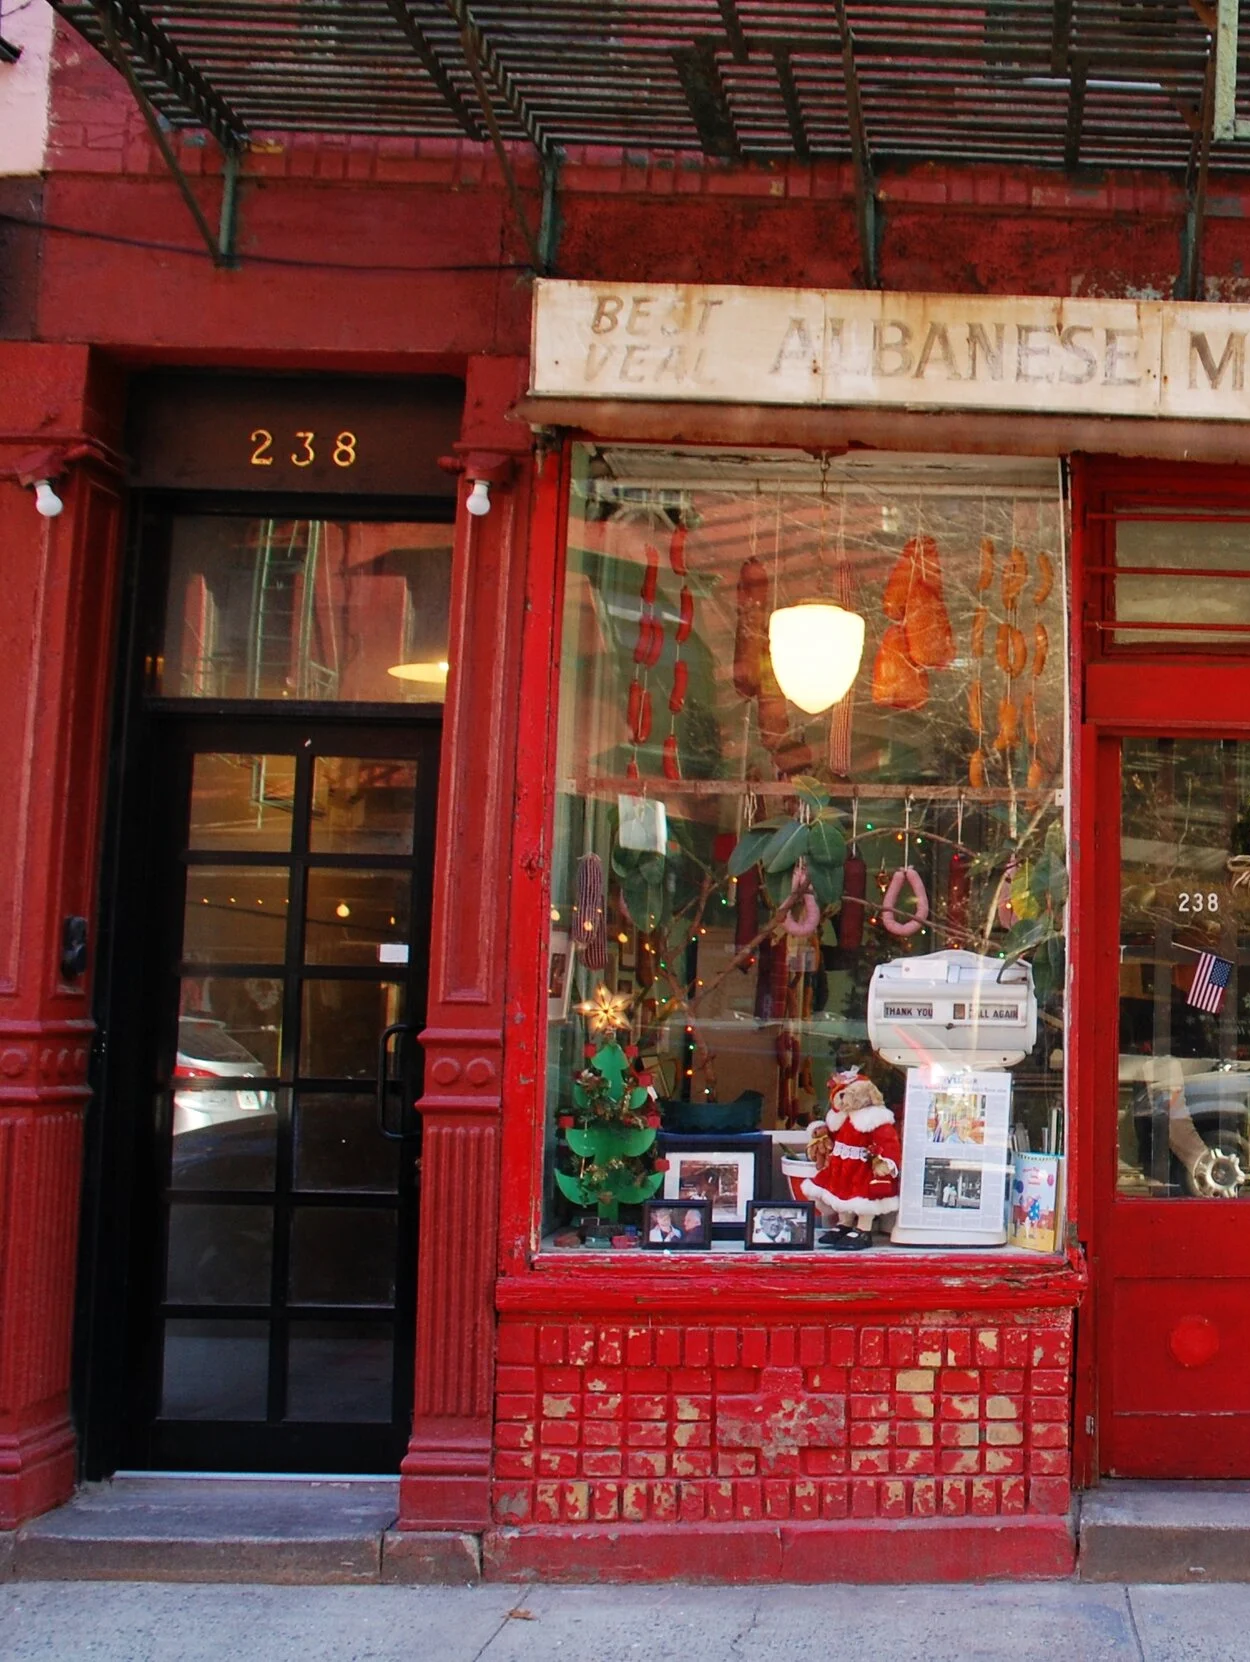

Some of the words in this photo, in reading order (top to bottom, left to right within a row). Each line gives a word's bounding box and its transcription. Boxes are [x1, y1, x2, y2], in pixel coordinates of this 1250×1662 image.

[767, 316, 1143, 388] ALBANESE
[250, 428, 357, 468] 238
[1178, 892, 1219, 912] 238
[885, 1006, 913, 1016] THANK
[916, 1006, 933, 1017] YOU
[992, 1008, 1018, 1020] AGAIN
